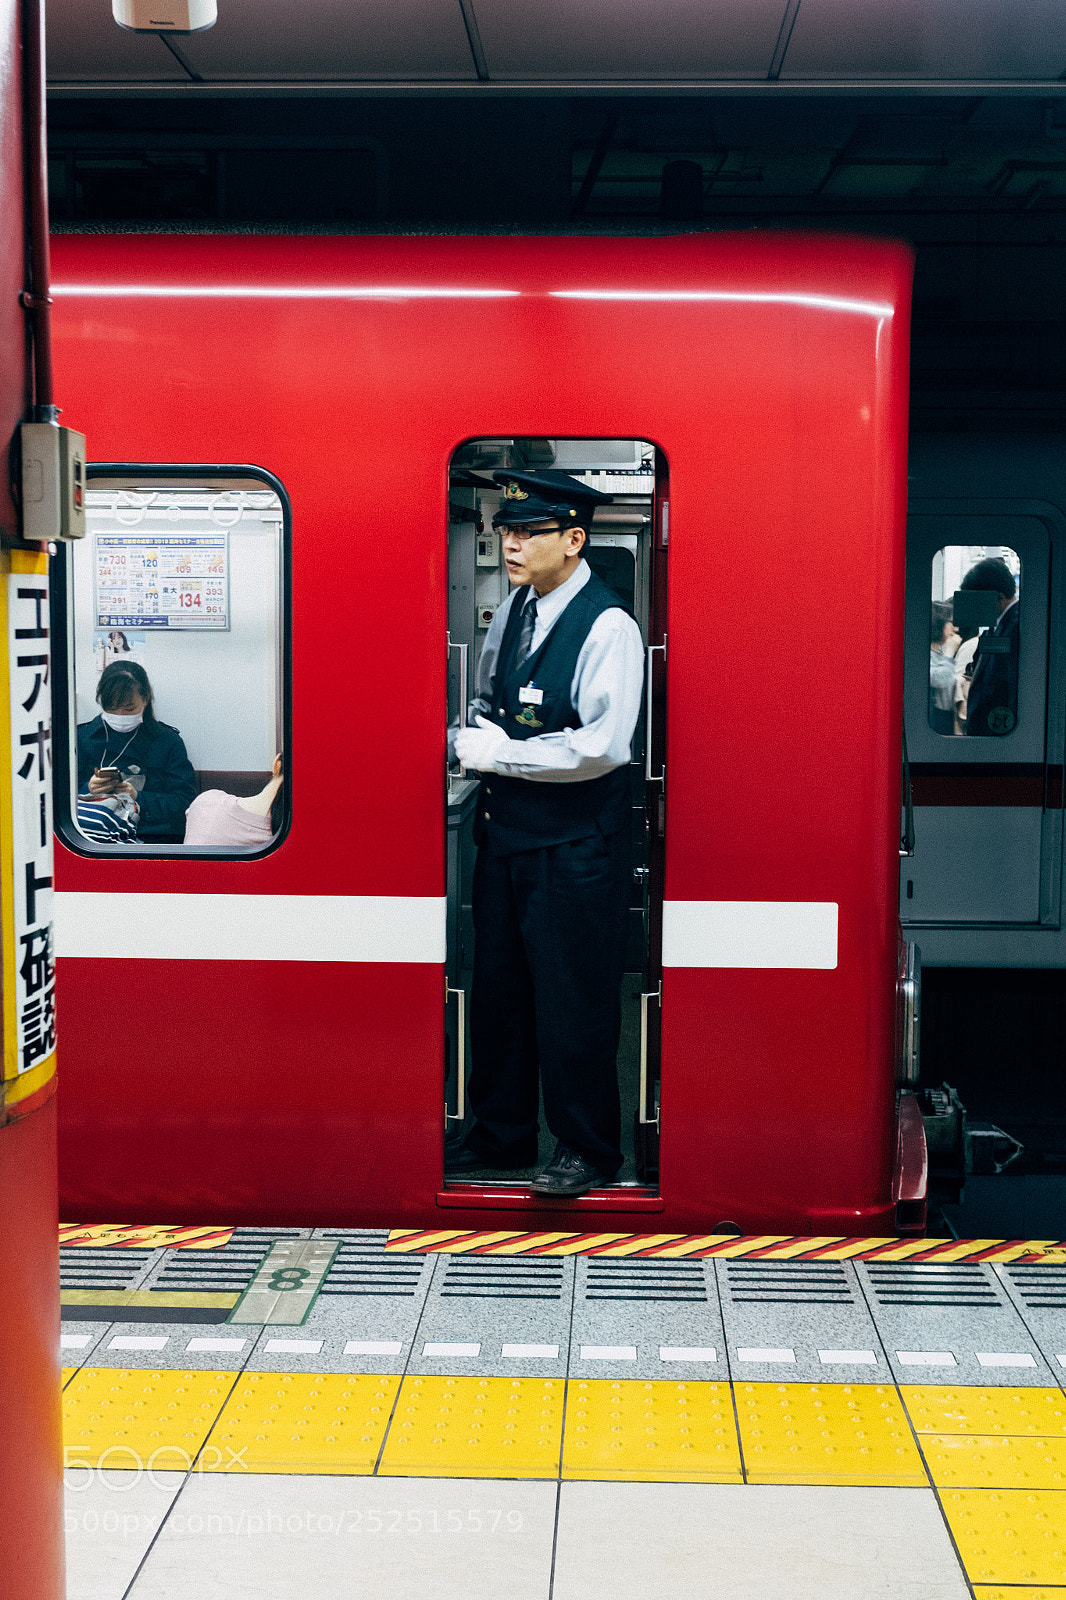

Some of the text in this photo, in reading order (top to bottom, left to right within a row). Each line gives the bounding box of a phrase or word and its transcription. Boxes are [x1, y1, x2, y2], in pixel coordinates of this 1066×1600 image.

[109, 555, 126, 564] 730
[142, 559, 158, 567] 120
[176, 565, 192, 573] 109
[207, 565, 224, 573] 146
[145, 592, 159, 600] 170
[206, 588, 223, 596] 393
[179, 593, 202, 607] 134
[206, 605, 222, 613] 961
[15, 588, 56, 1068] エアポート確認
[268, 1267, 311, 1291] 8
